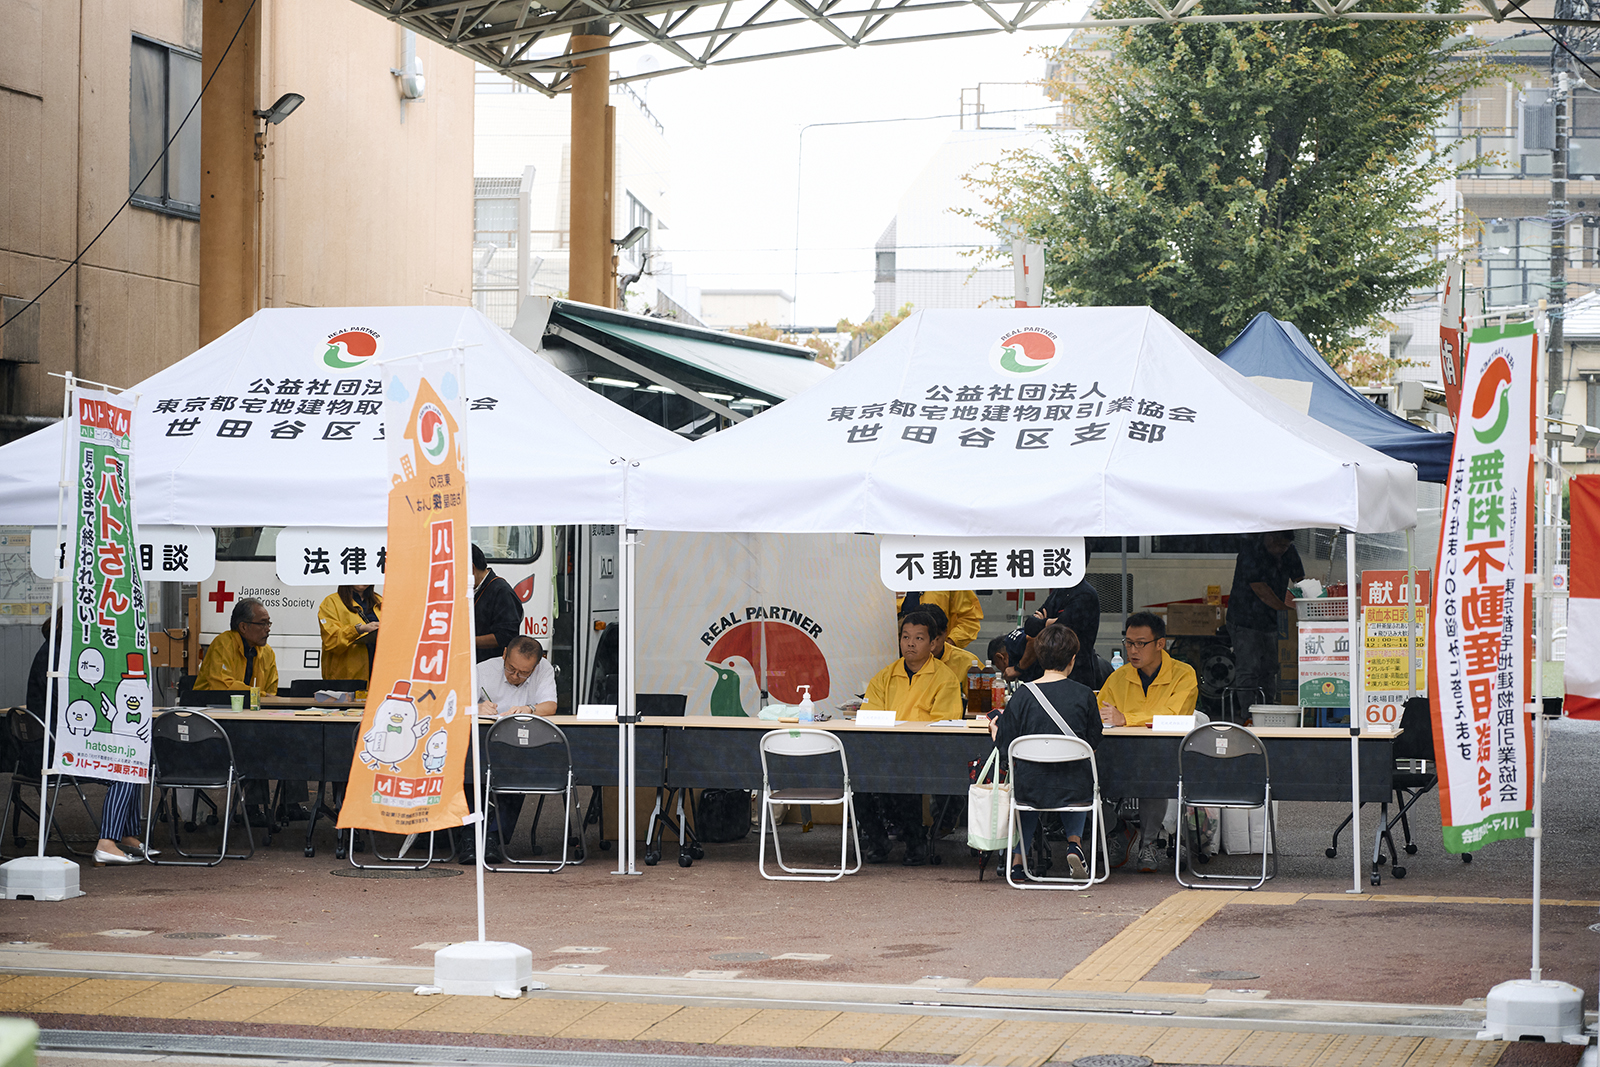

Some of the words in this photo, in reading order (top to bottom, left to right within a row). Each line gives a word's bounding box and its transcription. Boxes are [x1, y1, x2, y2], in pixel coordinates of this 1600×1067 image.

[327, 328, 349, 340] REAL
[350, 326, 381, 340] PARTNER
[1000, 328, 1022, 341] REAL
[1024, 326, 1058, 341] PARTNER
[247, 377, 383, 396] 公益社団法
[924, 381, 1107, 402] 公益社団法人
[152, 394, 498, 416] 東京都宅地建物取会
[827, 396, 1198, 423] 東京都宅地建物取引業協会
[82, 402, 128, 433] ハトさん
[165, 416, 386, 441] 世田谷区
[846, 420, 1167, 450] 世田谷区支部
[302, 546, 386, 576] 法律
[600, 558, 613, 575] 入口
[895, 548, 1073, 580] 不動産相談
[238, 586, 281, 597] Japanese
[1368, 580, 1423, 605] 献血
[282, 597, 315, 609] Society
[525, 616, 548, 635] No.3
[1367, 608, 1424, 622] 献血本日実中
[700, 612, 742, 647] REAL
[745, 606, 823, 639] PARTNER
[1304, 634, 1350, 655] 献血
[1366, 704, 1397, 723] 60
[85, 739, 137, 759] hatosan.jp
